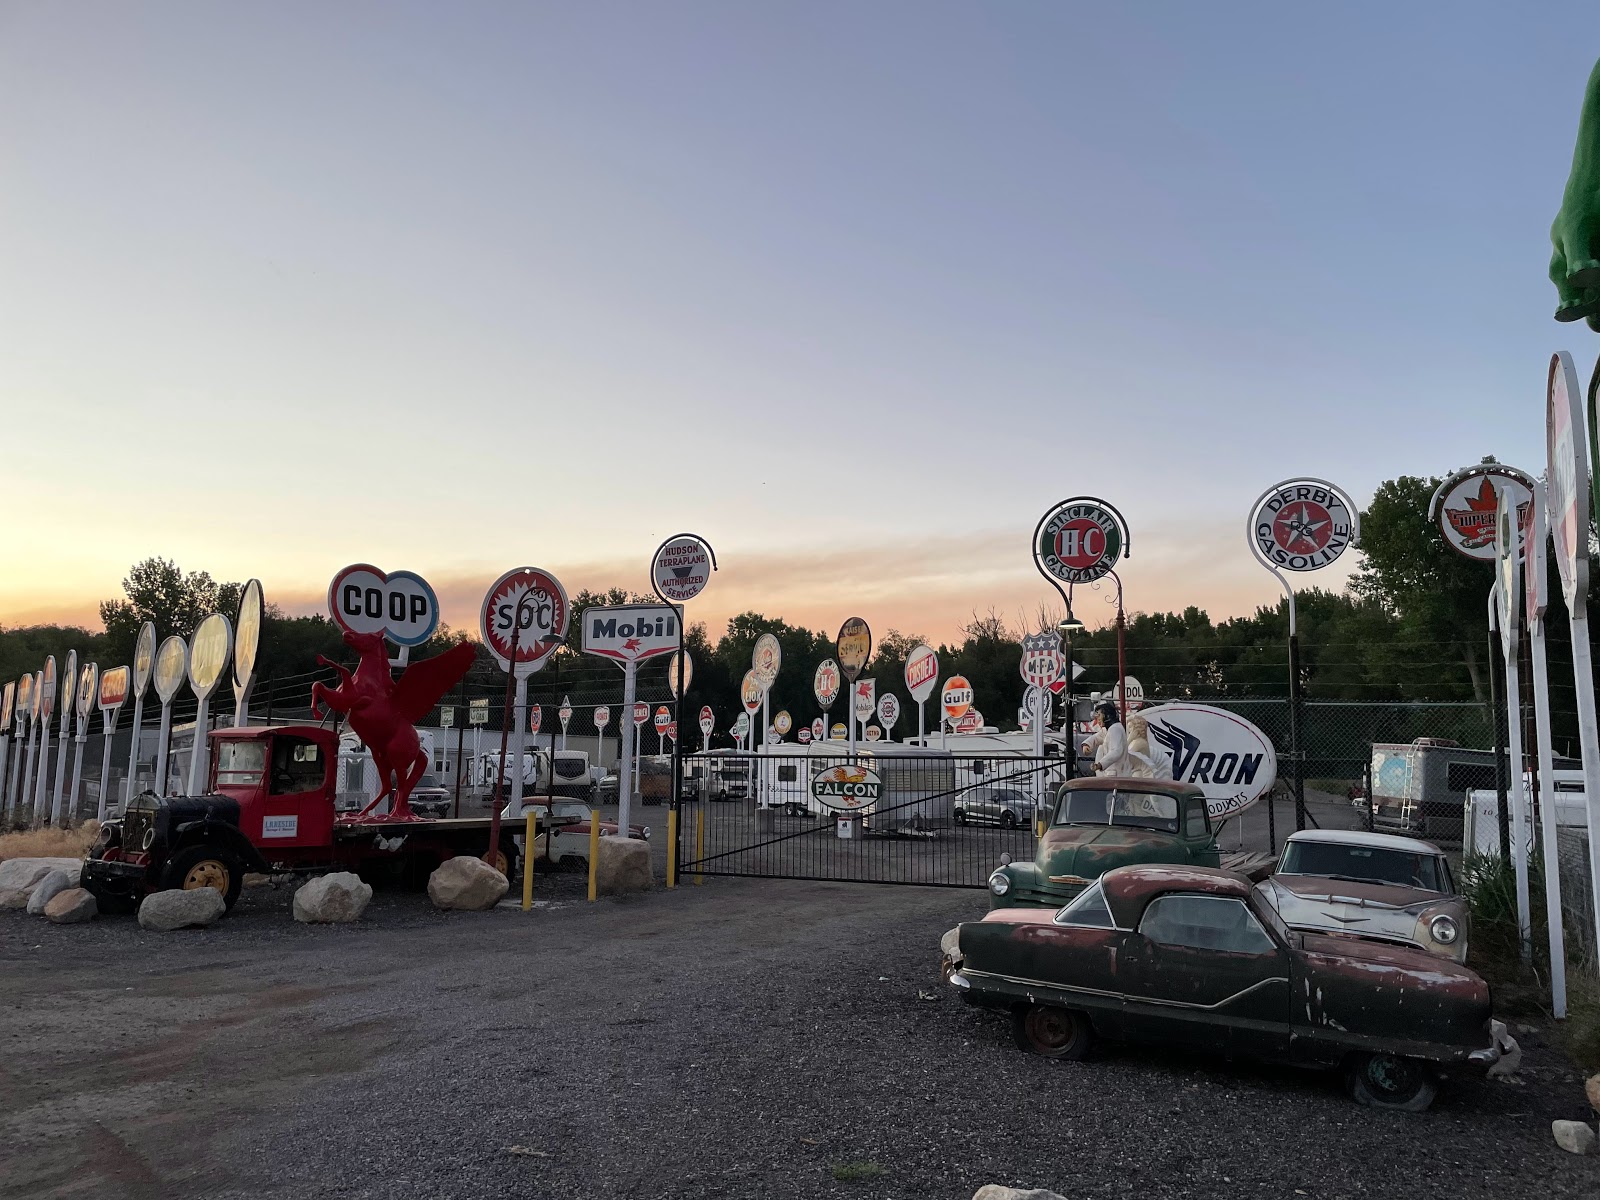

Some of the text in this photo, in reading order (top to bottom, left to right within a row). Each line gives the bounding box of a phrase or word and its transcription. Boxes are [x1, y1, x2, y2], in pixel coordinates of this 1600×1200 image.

[1267, 488, 1341, 513] DERBY
[1048, 507, 1114, 535] SINCLAIR
[665, 545, 698, 557] HUDSON
[1258, 523, 1349, 569] GASOLINE
[659, 555, 706, 568] TERRAPLANE
[661, 575, 703, 587] AUTHORIZED
[666, 585, 698, 599] SERVICE
[592, 616, 675, 638] Mobil
[909, 656, 934, 686] COSDEN
[943, 691, 970, 704] Gulf
[815, 782, 878, 797] FALCON
[1208, 791, 1248, 814] ODUCTS
